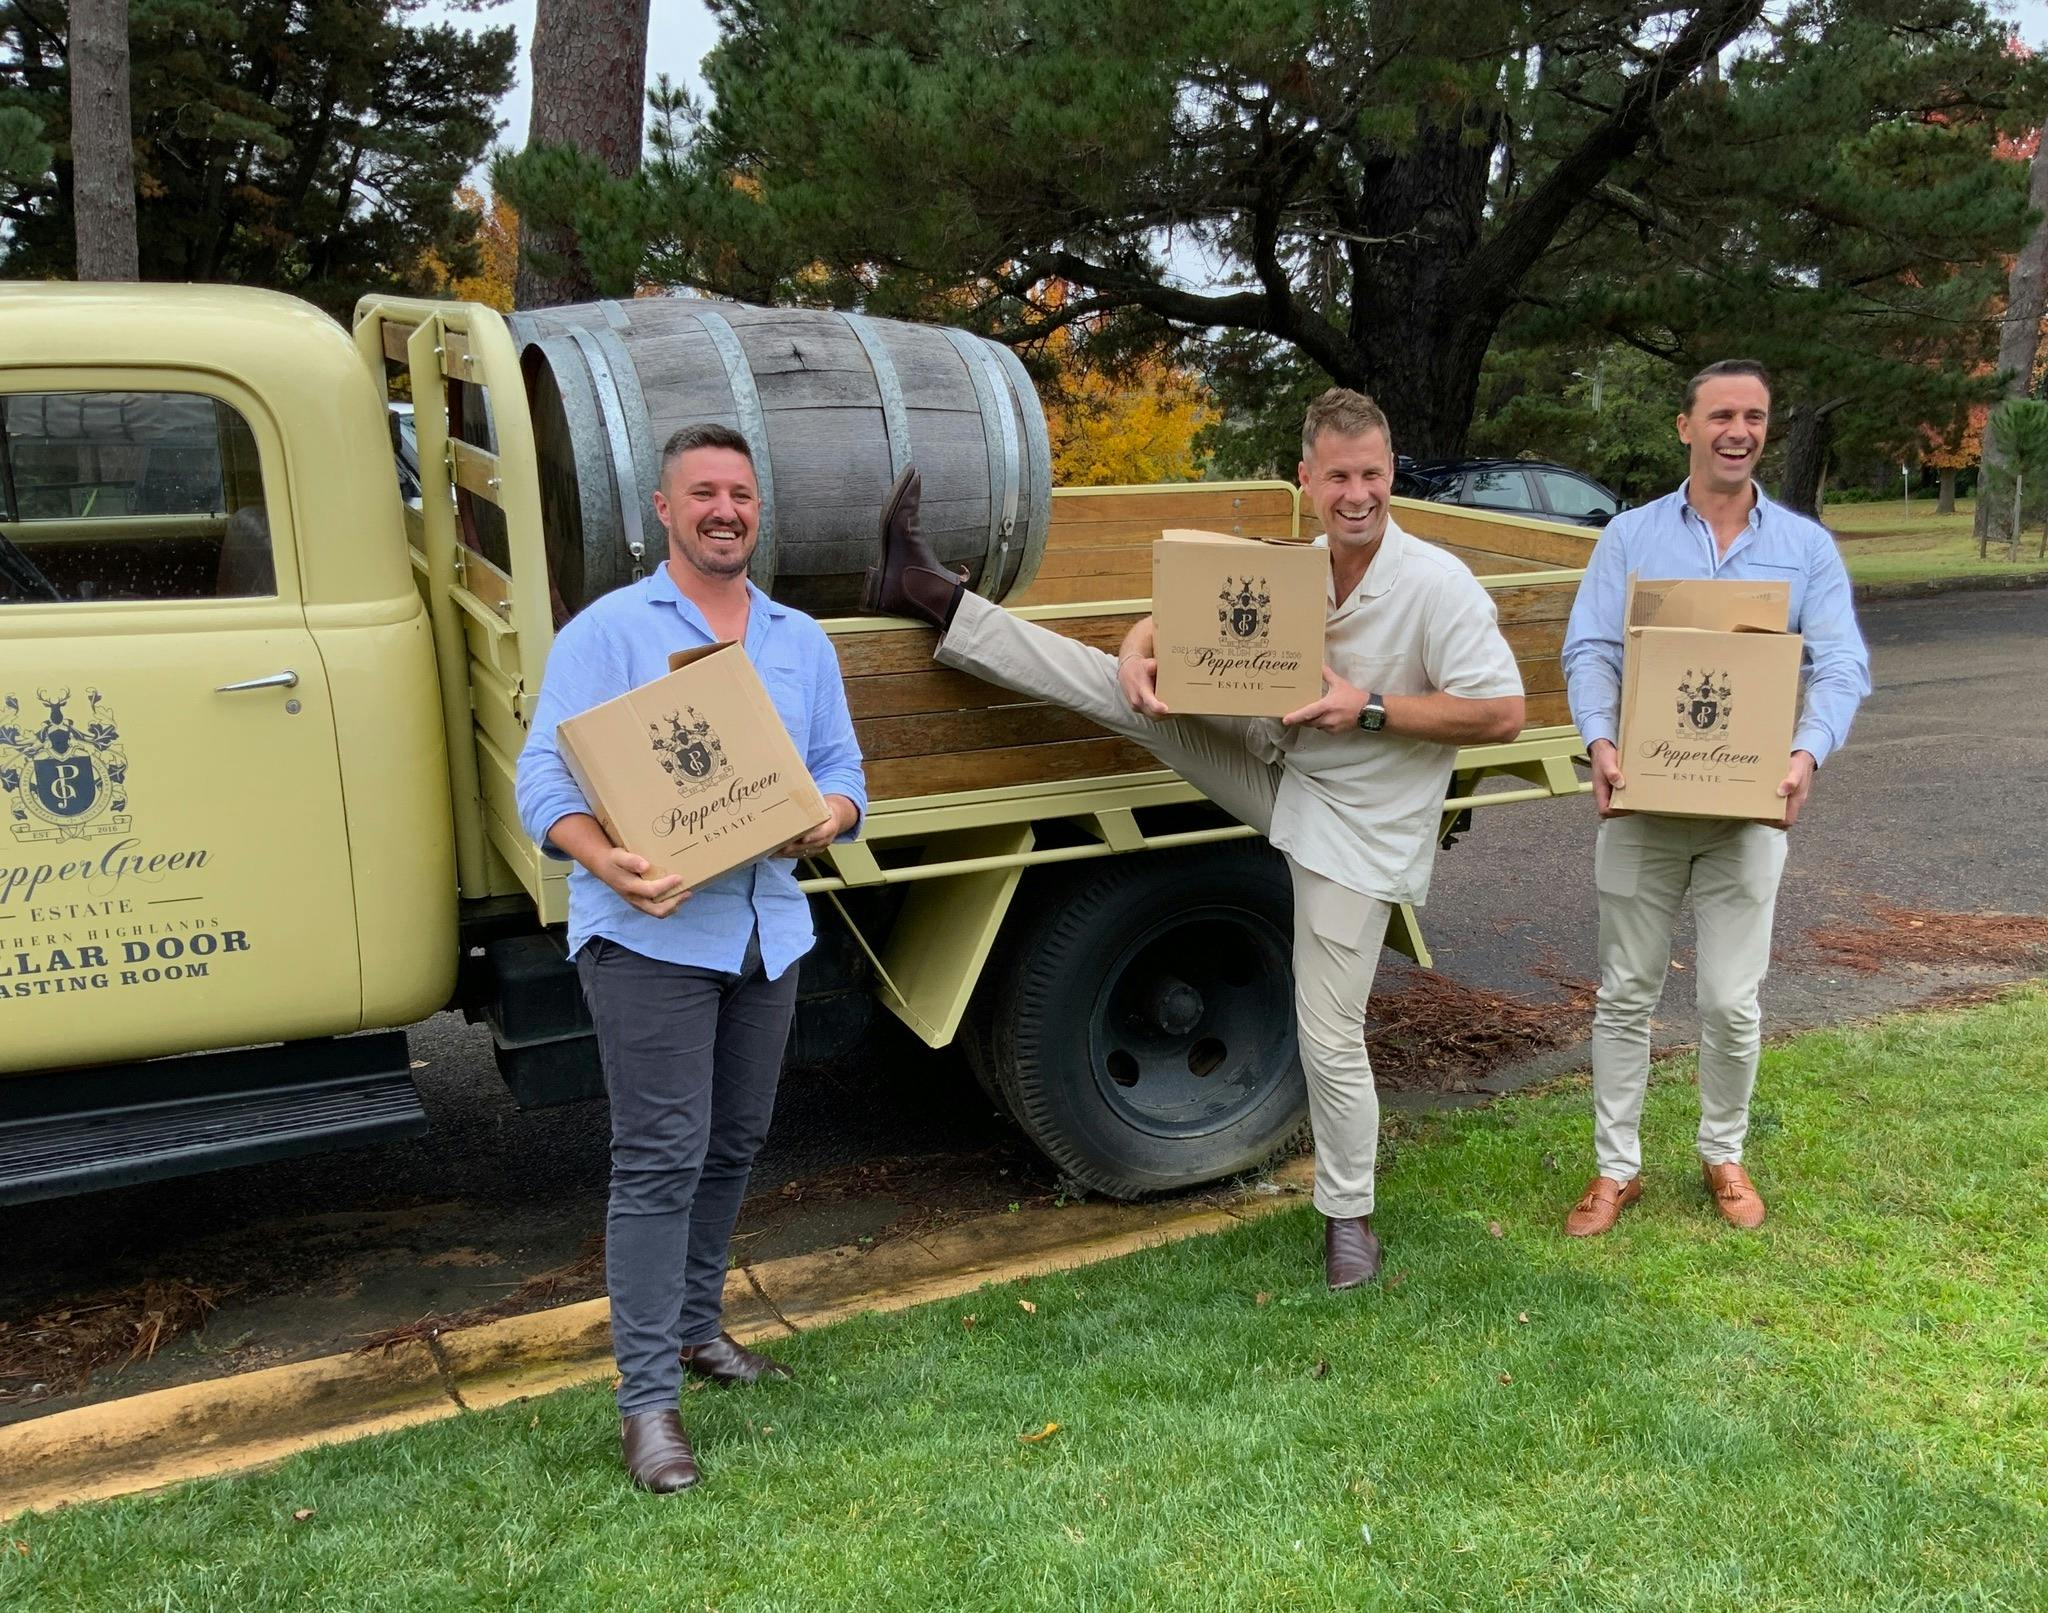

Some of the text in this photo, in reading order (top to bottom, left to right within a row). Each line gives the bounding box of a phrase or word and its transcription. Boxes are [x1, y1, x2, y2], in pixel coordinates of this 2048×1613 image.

[1183, 647, 1301, 679] PepperGreen
[1217, 680, 1265, 691] ESTATE
[1640, 739, 1761, 770] PepperGreen
[1672, 773, 1723, 784] ESTATE
[651, 770, 781, 838] PepperGreen
[97, 825, 119, 834] 2016
[703, 812, 757, 844] ESTATE
[30, 899, 134, 923] ESTATE
[88, 916, 220, 941] HIGHLANDS
[123, 930, 251, 964] DOOR
[121, 961, 211, 986] ROOM
